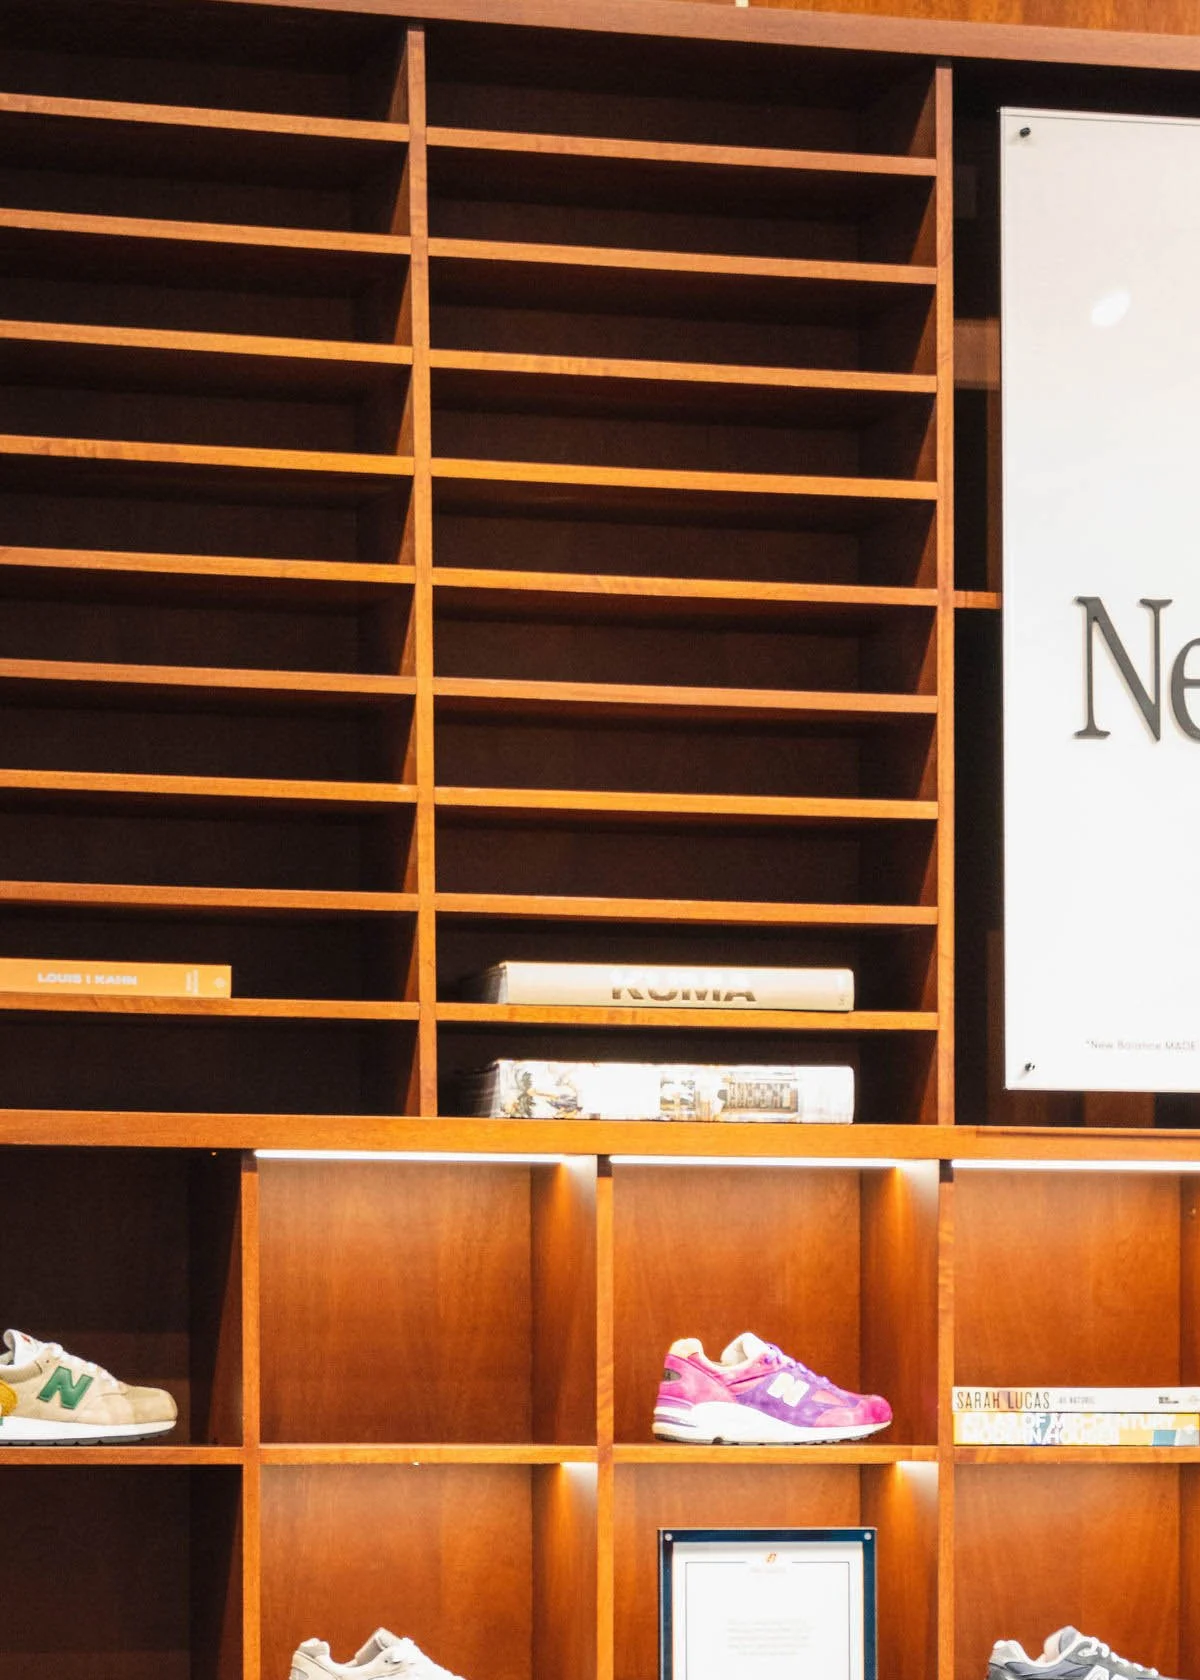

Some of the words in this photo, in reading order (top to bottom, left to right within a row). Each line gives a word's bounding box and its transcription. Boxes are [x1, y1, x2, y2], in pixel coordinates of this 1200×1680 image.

[37, 972, 82, 984] LOUIS
[1165, 1041, 1196, 1051] MADE
[37, 1366, 94, 1410] N
[766, 1372, 810, 1407] N
[957, 1391, 1000, 1409] SARAH
[1008, 1391, 1050, 1409] LUCAS
